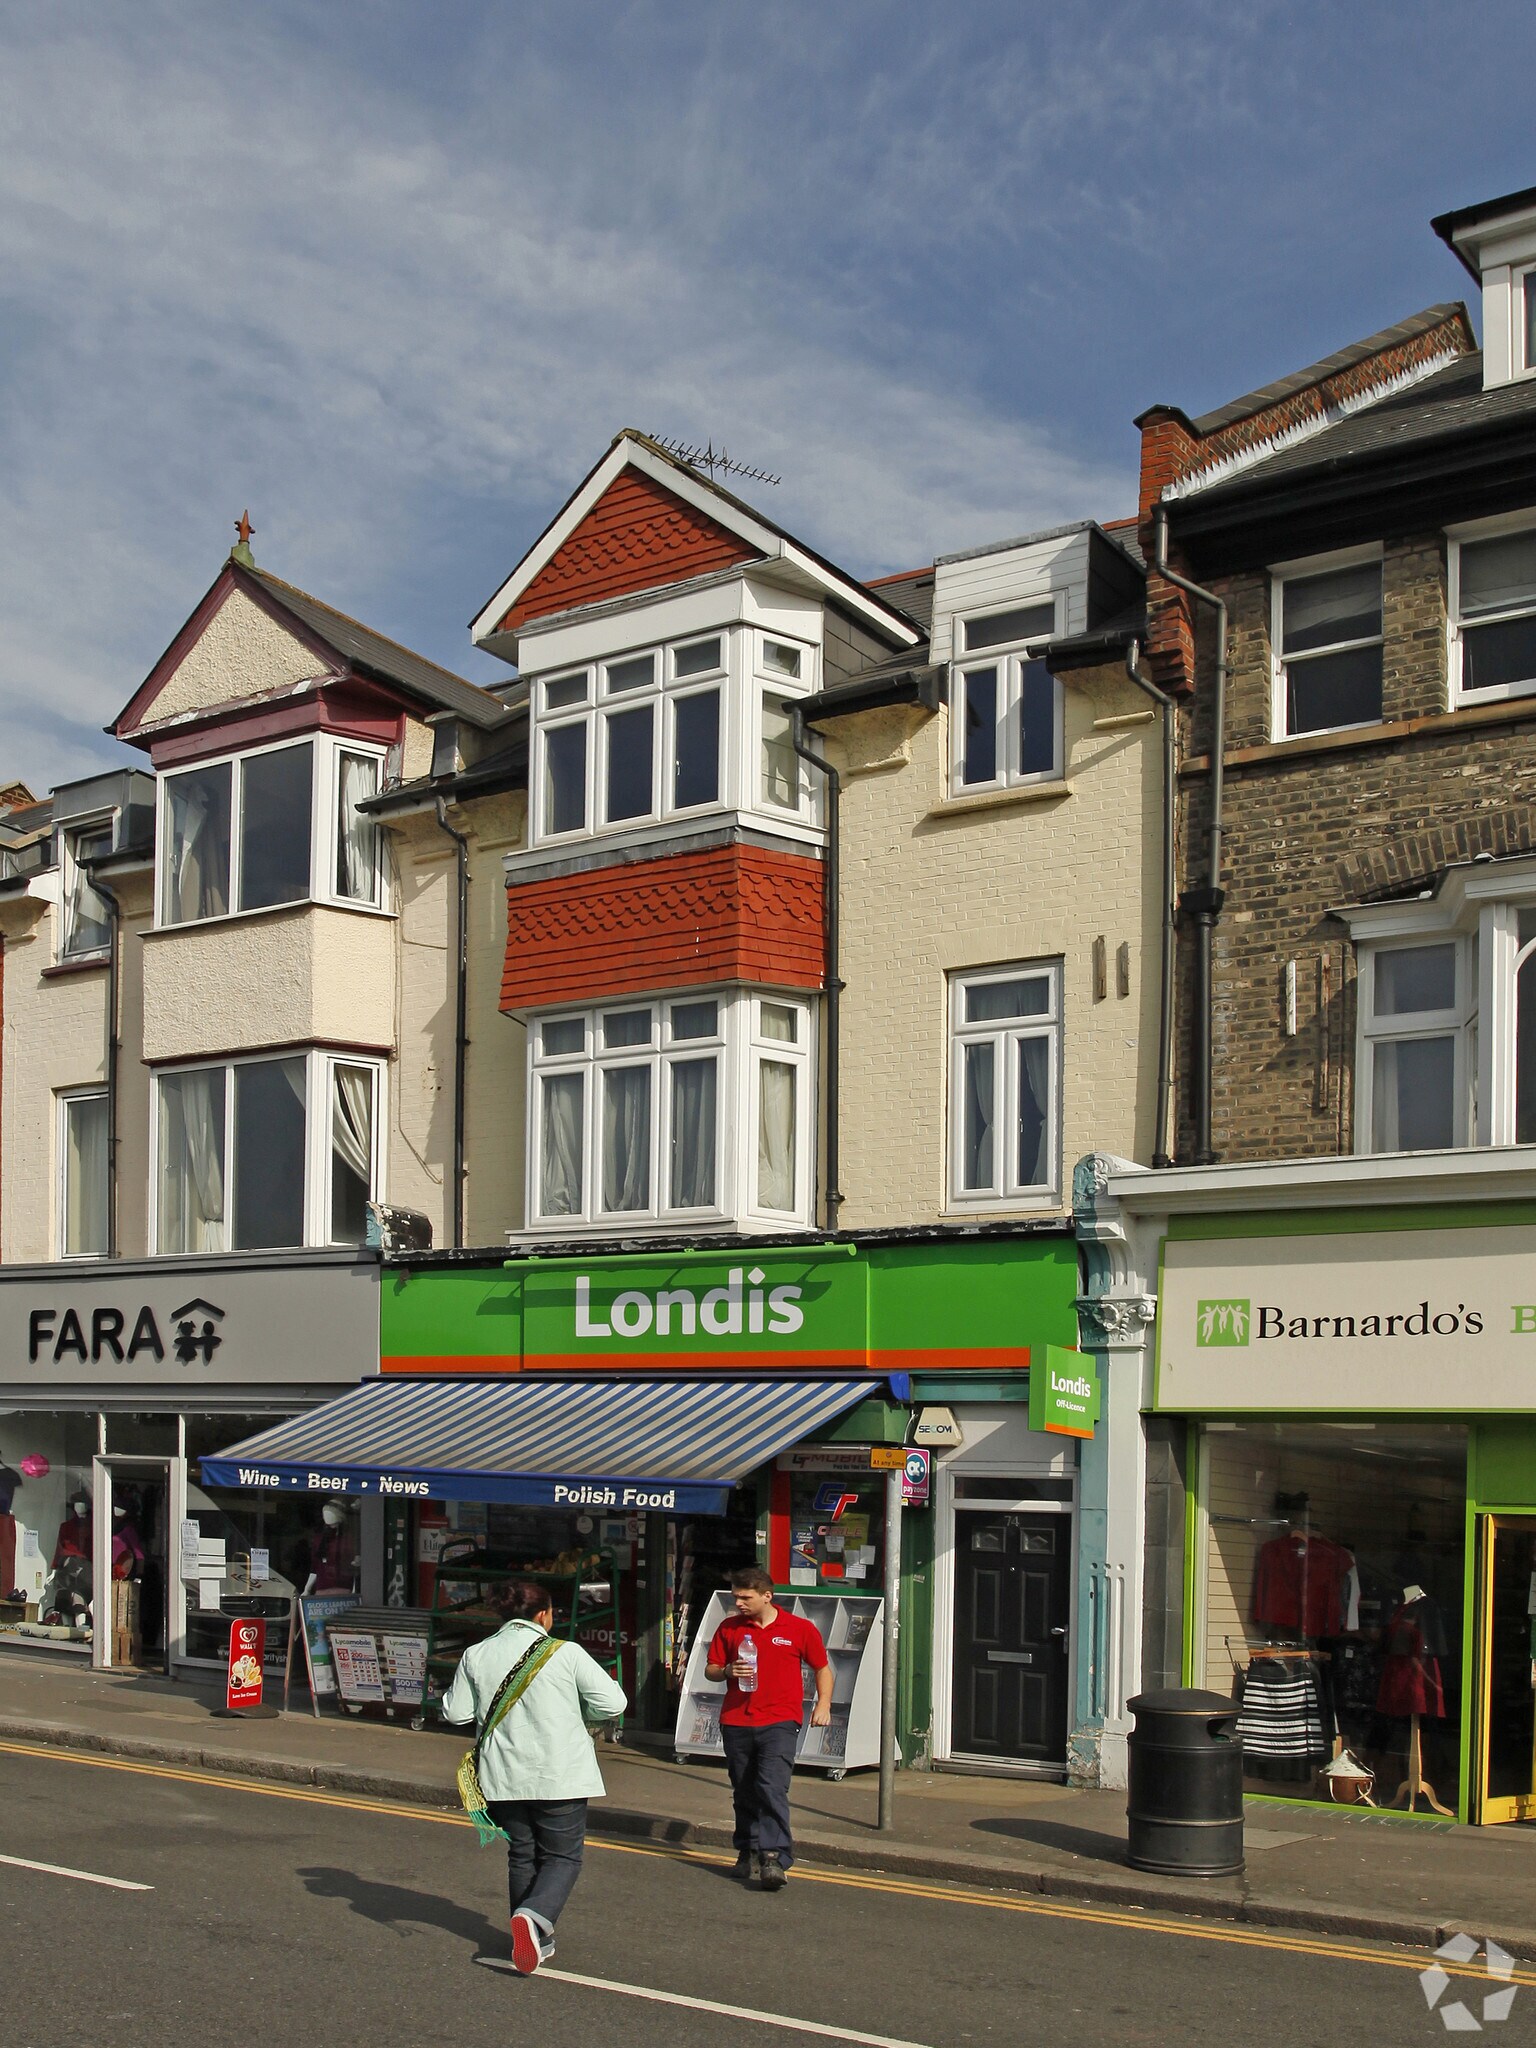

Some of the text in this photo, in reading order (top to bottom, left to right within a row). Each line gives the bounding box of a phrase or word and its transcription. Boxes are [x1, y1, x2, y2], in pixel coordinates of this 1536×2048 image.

[575, 1266, 804, 1338] Londis
[1256, 1300, 1484, 1340] Barnardo's
[29, 1305, 165, 1364] FARA
[1051, 1370, 1091, 1398] Londis
[918, 1424, 952, 1434] SECOM
[238, 1468, 430, 1496] Wine Beer News
[554, 1484, 676, 1508] Polish Food
[903, 1485, 927, 1495] payzone
[1004, 1515, 1020, 1527] 74
